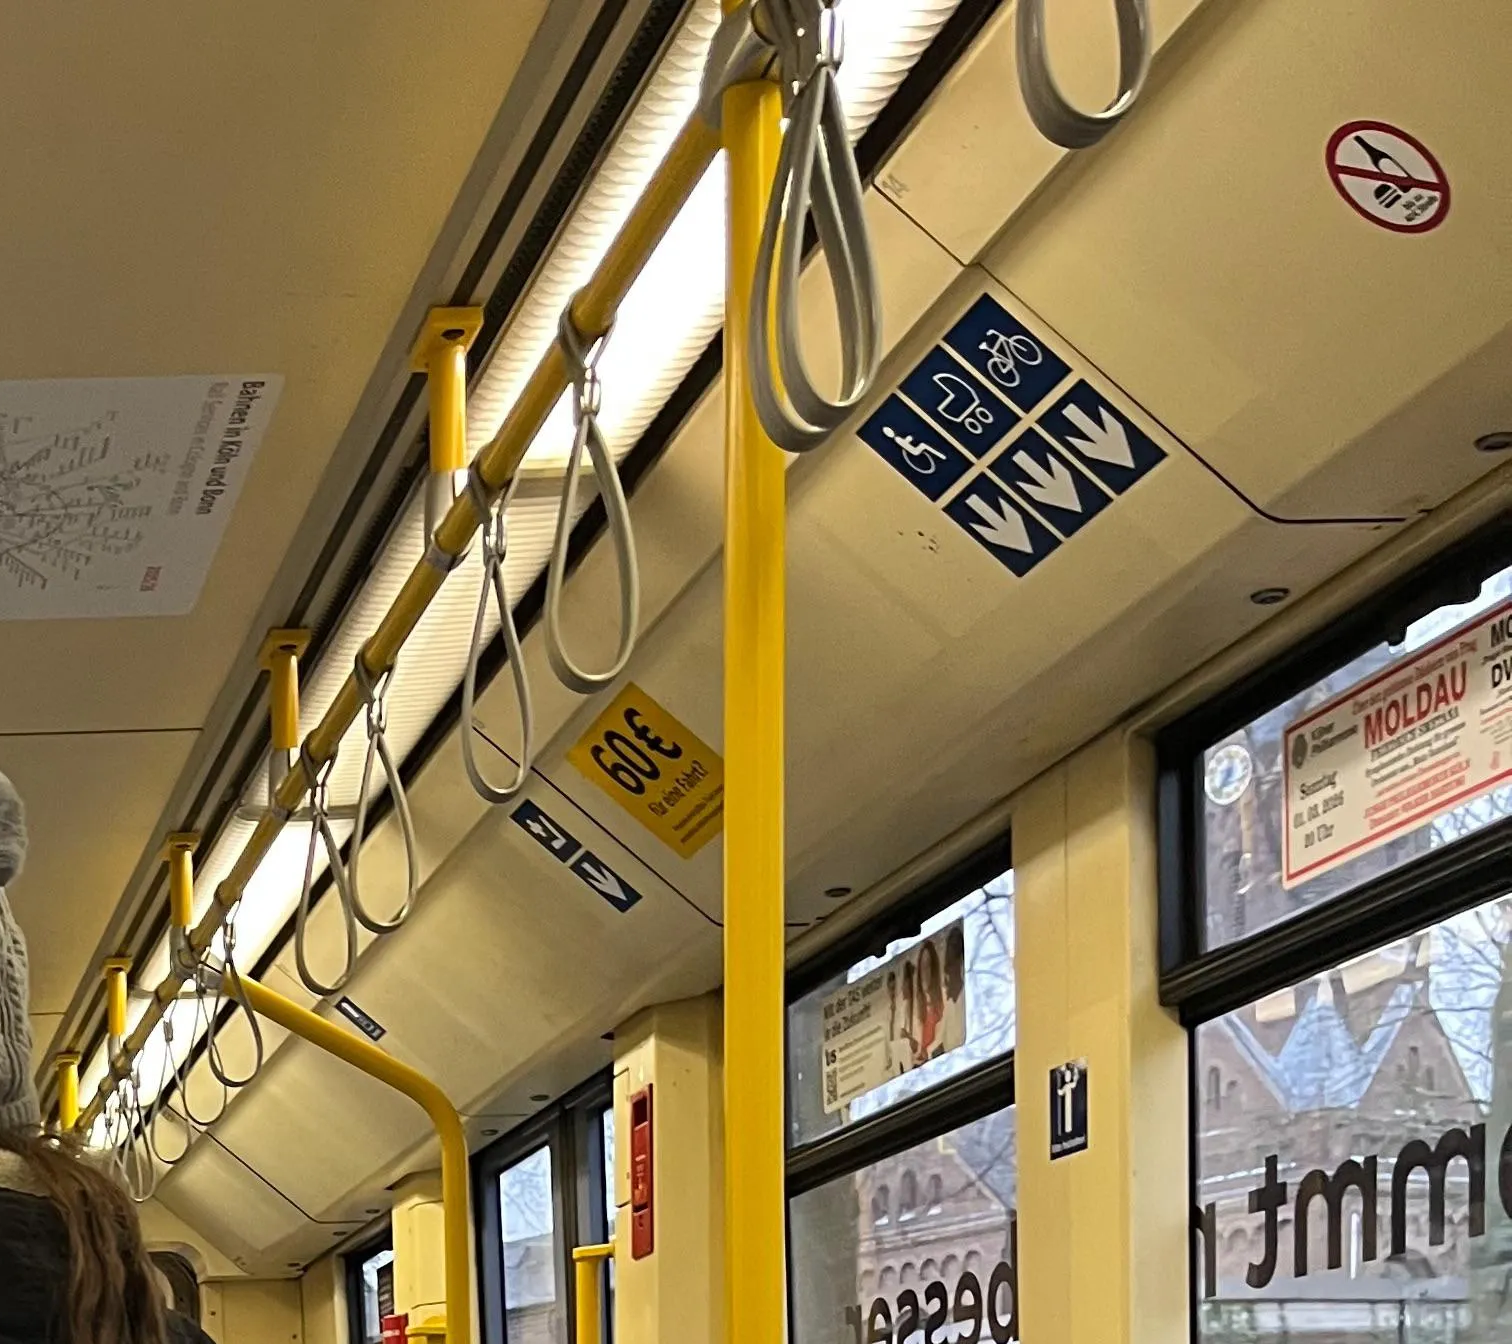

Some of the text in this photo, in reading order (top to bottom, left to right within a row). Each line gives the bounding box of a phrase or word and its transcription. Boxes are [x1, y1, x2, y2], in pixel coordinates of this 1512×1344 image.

[1363, 661, 1469, 750] MOLDAU
[590, 707, 683, 795] 60 €
